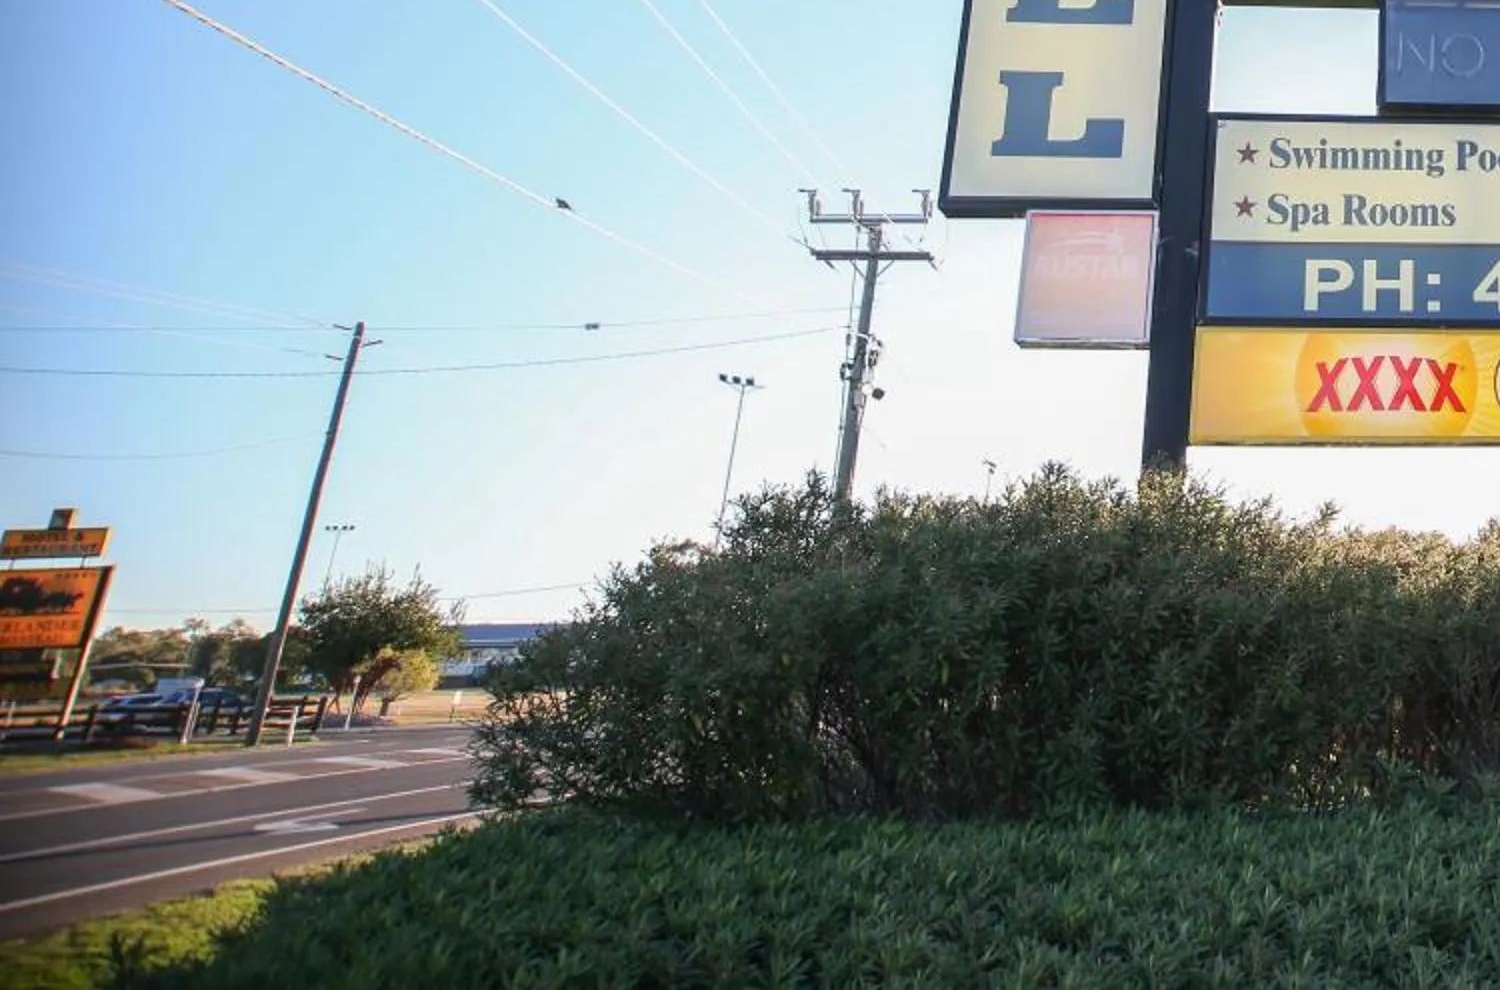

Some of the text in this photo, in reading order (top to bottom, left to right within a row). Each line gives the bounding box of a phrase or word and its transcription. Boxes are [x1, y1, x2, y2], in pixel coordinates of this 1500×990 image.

[1397, 31, 1484, 77] NO
[1269, 137, 1445, 178] Swimming
[1266, 193, 1457, 232] Spa Rooms
[1303, 259, 1441, 312] PH:
[1305, 355, 1467, 413] XXXX
